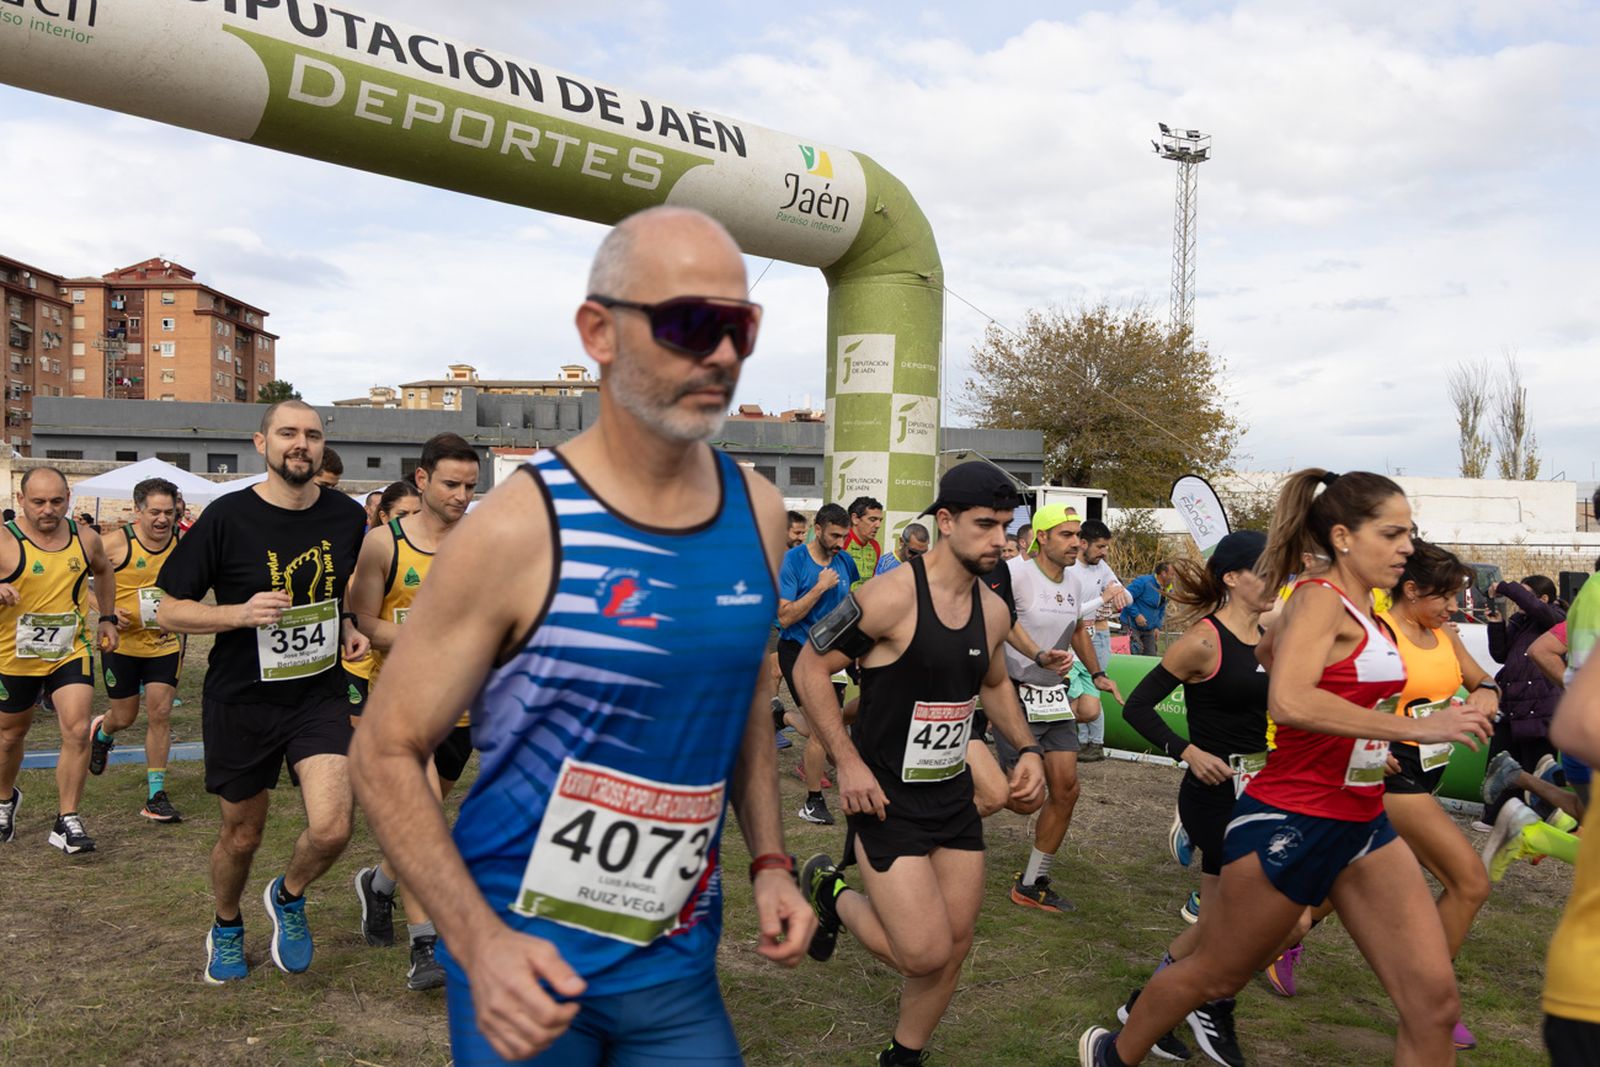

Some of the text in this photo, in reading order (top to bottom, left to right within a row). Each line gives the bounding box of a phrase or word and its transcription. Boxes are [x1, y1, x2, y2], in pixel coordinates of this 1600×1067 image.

[30, 17, 94, 44] interior
[287, 53, 664, 190] DEPORTES
[556, 75, 624, 124] DE
[636, 100, 747, 158] JAÉN
[780, 173, 849, 222] Jaén
[32, 627, 60, 642] 27
[271, 622, 326, 654] 354
[551, 809, 710, 881] 4073
[577, 886, 666, 914] RUIZ VEGA
